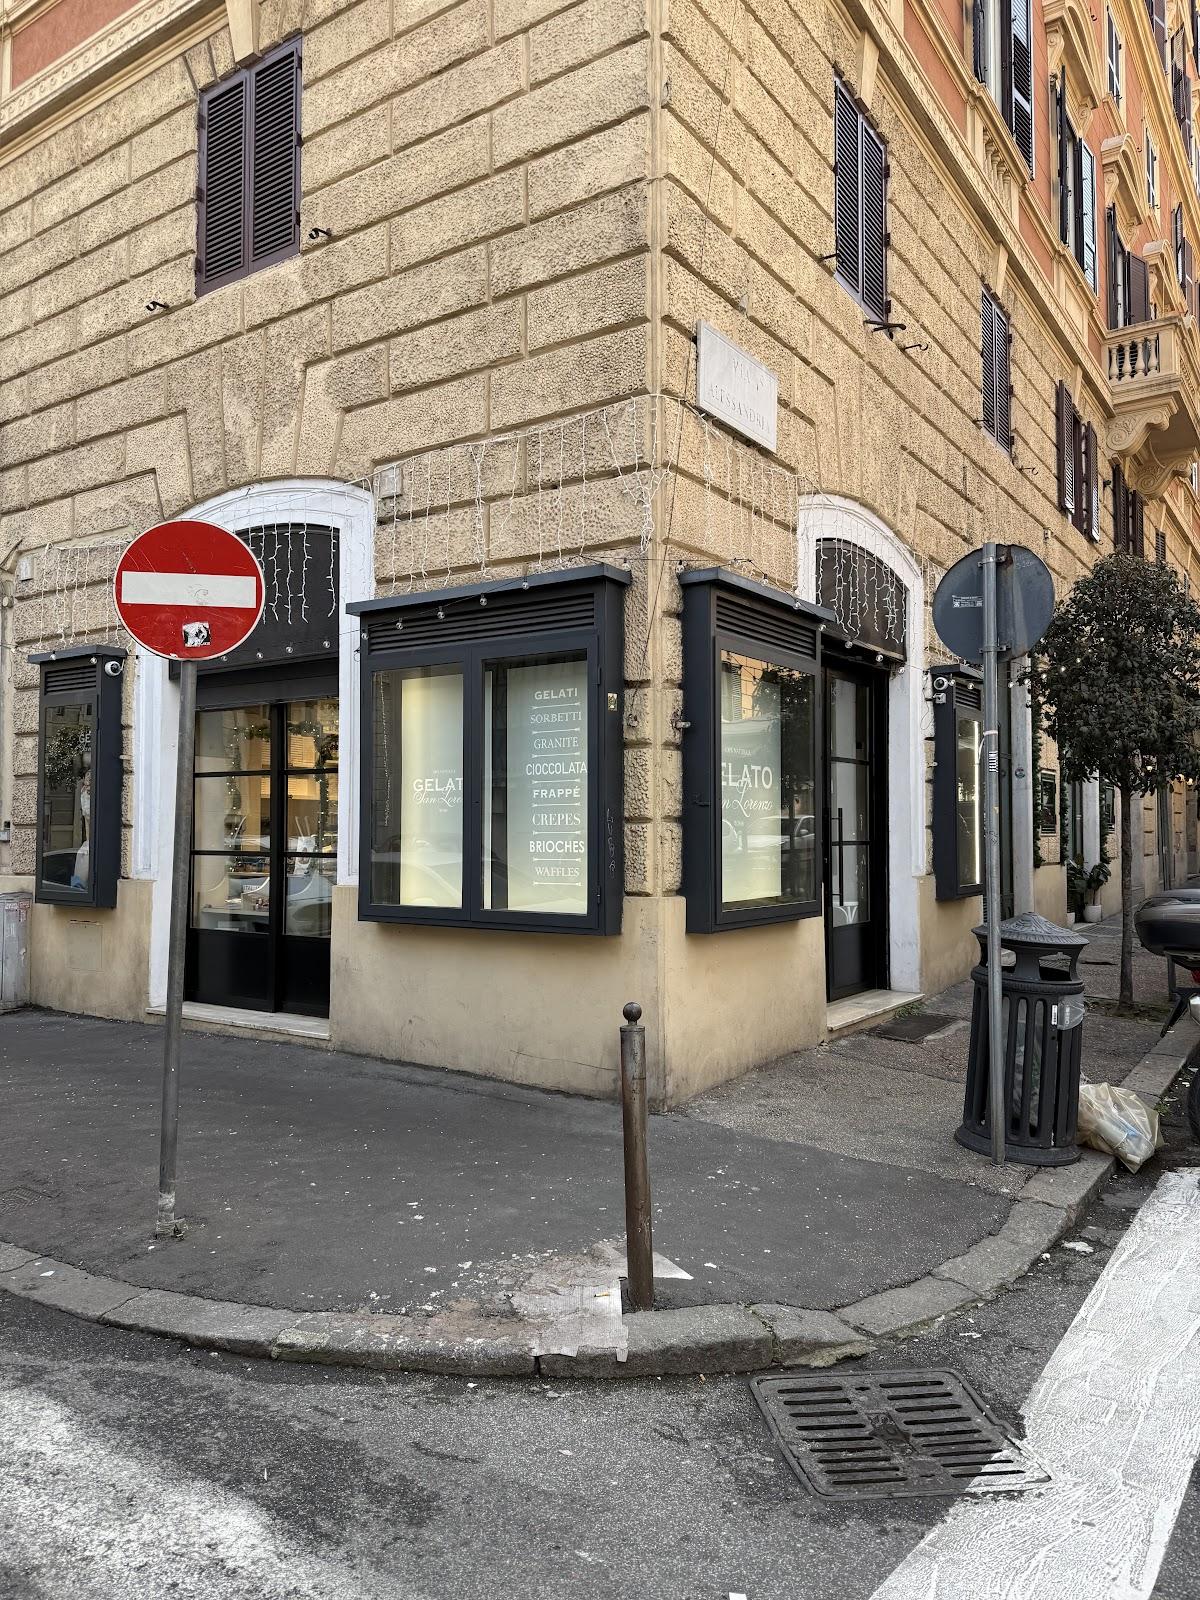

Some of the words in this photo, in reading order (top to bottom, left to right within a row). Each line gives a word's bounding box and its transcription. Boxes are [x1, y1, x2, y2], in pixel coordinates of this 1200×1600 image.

[732, 358, 751, 385] VIA
[534, 687, 578, 700] GELATI
[530, 711, 582, 724] SORBETTI
[533, 736, 579, 749] GRANITE
[526, 761, 587, 776] CIOCCOLATA
[532, 785, 580, 799] FRAPPÉ
[732, 779, 773, 818] Lorenzo
[532, 812, 581, 826] CREPES
[529, 840, 585, 853] BRIOCHES
[534, 866, 580, 877] WAFFLES
